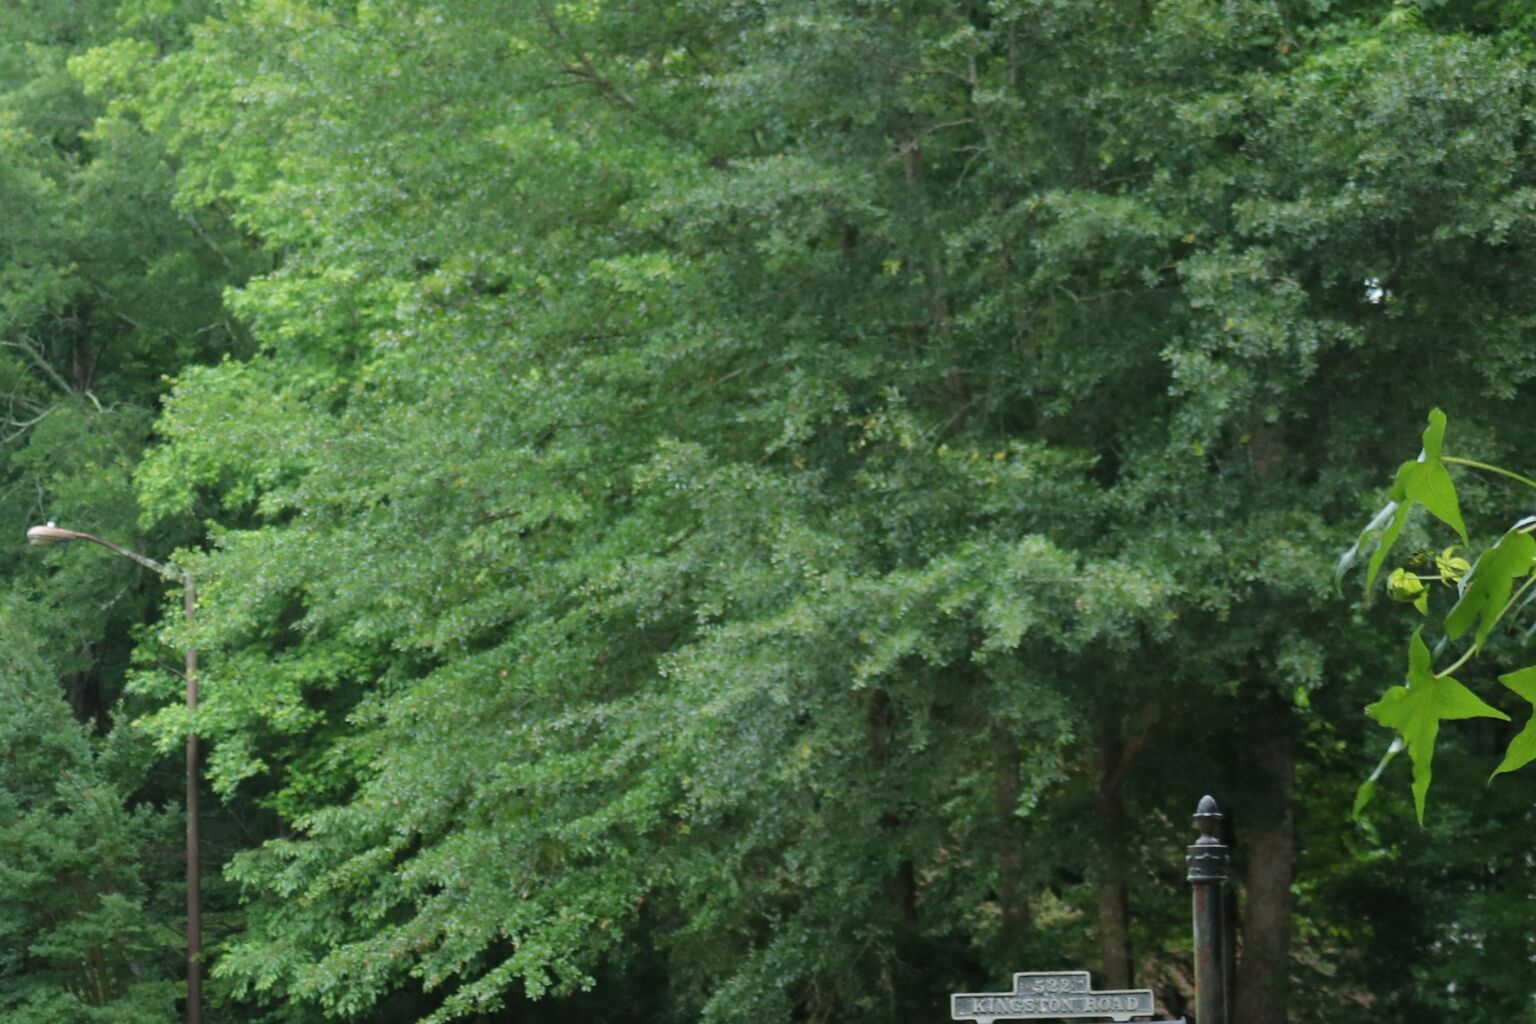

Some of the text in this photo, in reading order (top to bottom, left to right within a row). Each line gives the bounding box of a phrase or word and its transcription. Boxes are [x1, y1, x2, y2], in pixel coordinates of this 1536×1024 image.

[1032, 979, 1072, 993] 522
[972, 995, 1139, 1015] KINGSTON ROAD
